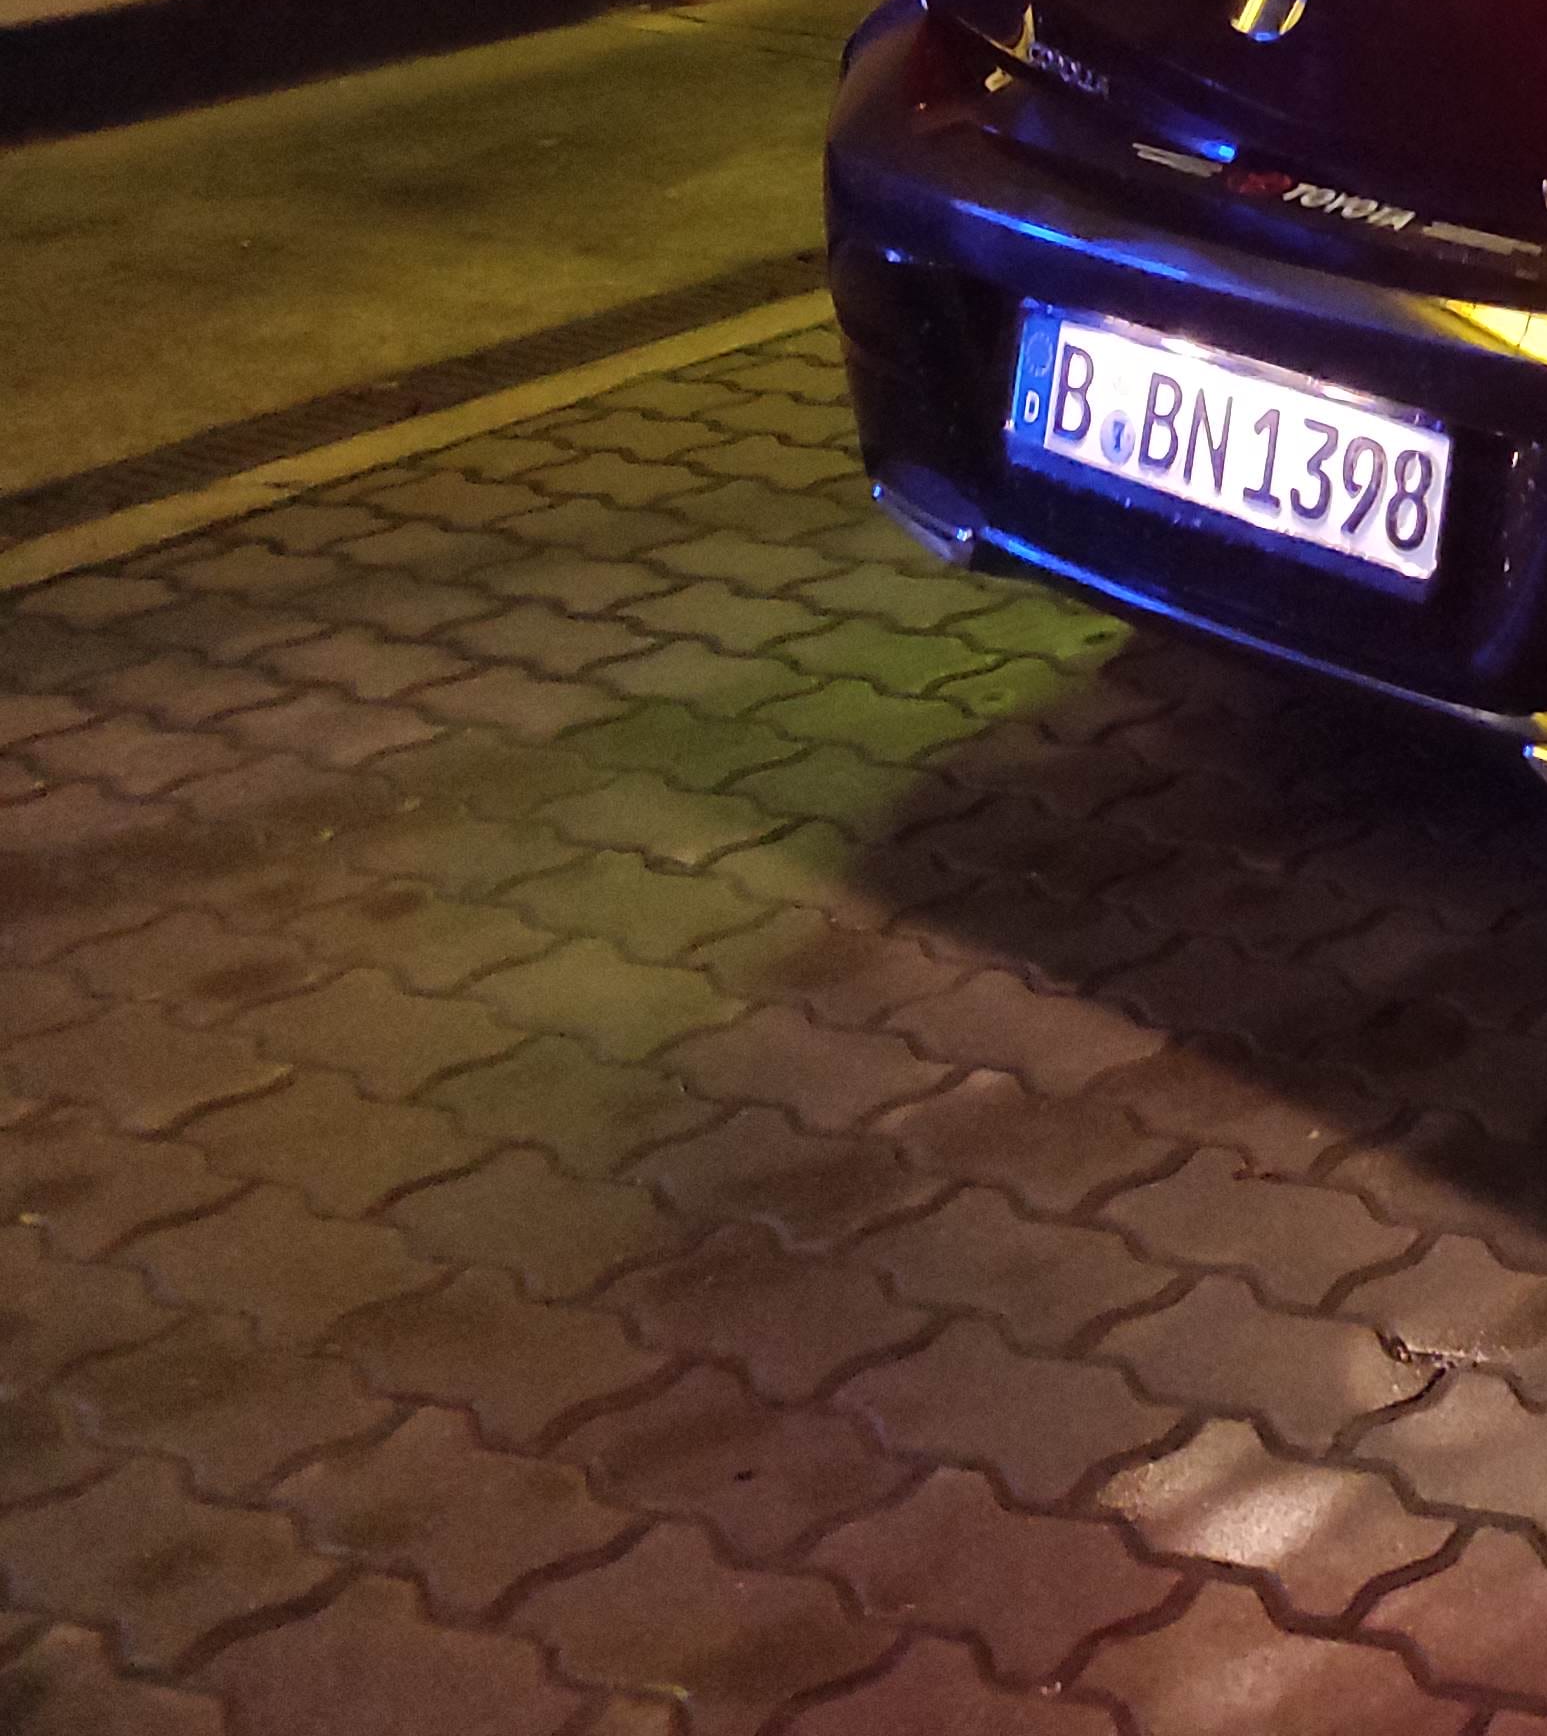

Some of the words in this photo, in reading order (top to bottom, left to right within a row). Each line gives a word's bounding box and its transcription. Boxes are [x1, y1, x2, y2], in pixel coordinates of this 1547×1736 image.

[1282, 181, 1417, 232] TOYOTA
[1023, 389, 1041, 424] D
[1053, 343, 1095, 441] B
